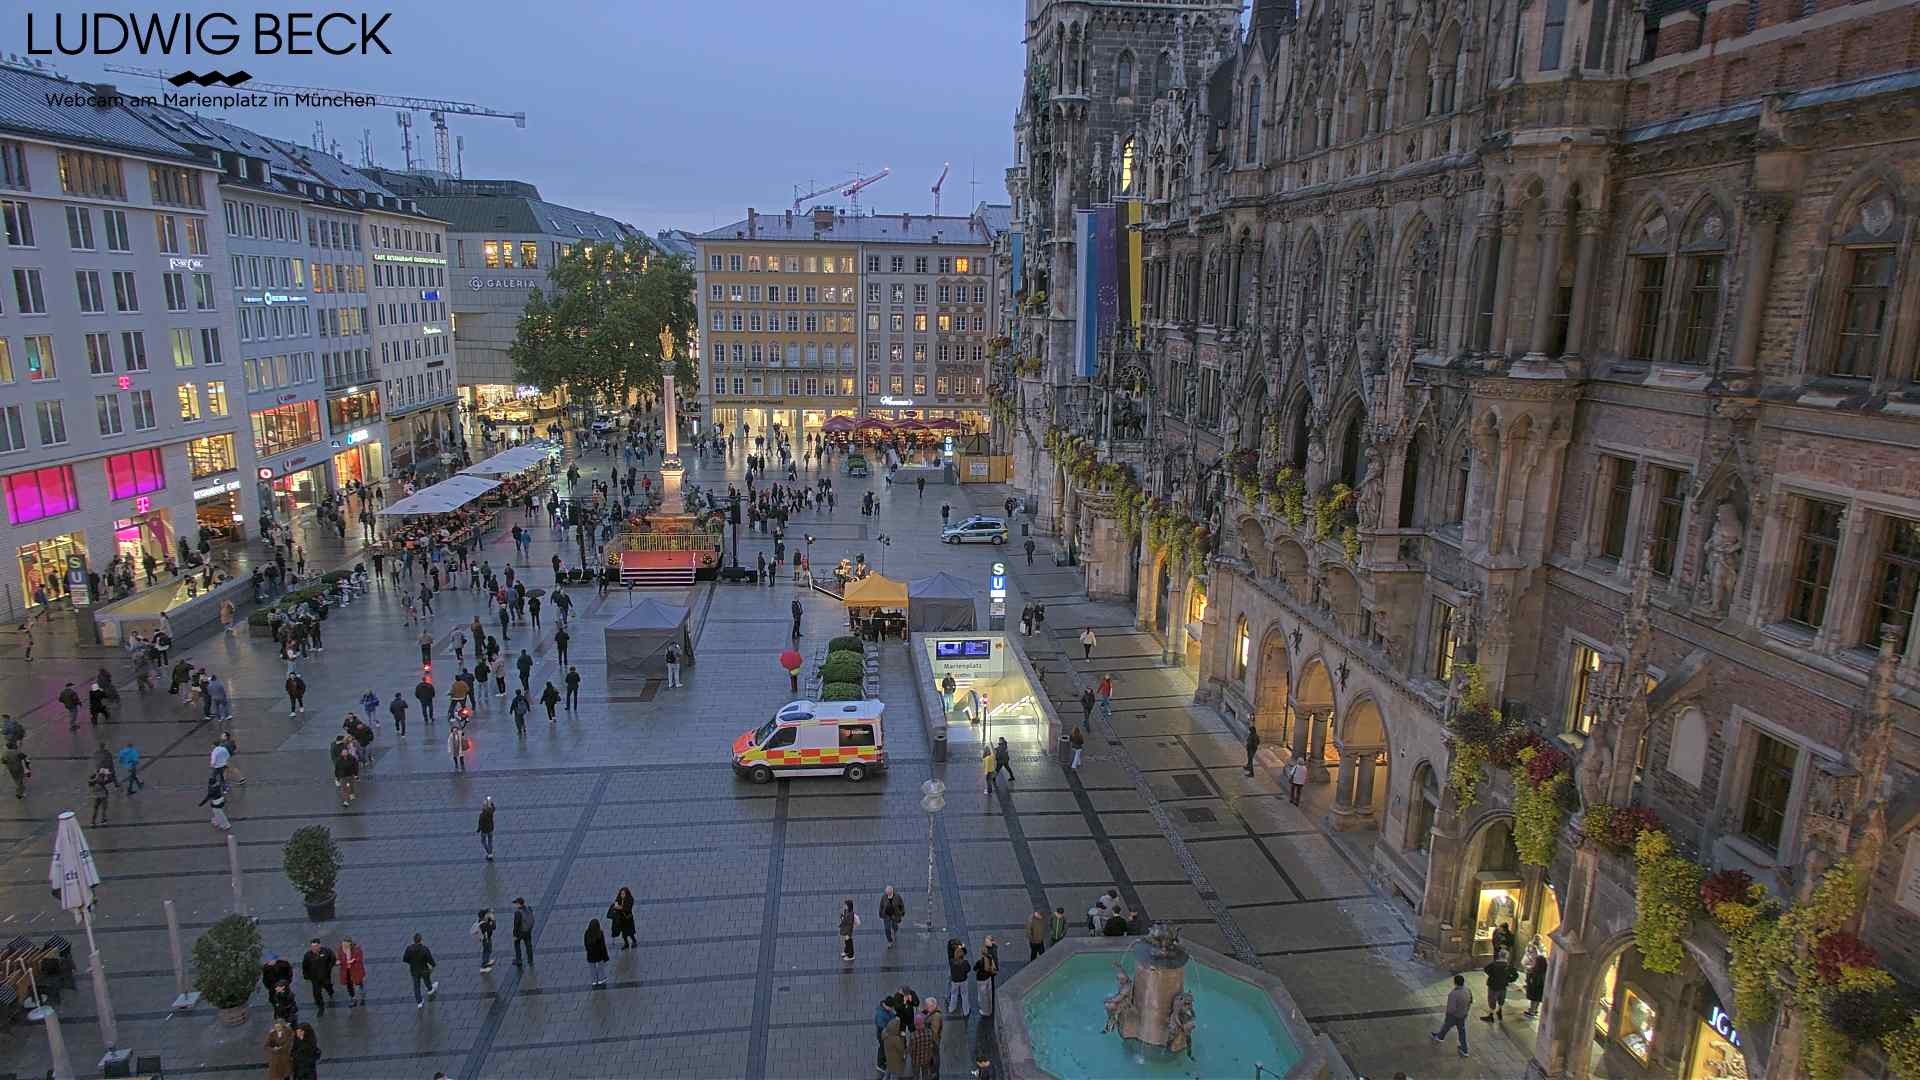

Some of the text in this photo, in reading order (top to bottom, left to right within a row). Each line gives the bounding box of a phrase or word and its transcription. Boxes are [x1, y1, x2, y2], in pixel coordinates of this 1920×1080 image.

[486, 279, 537, 289] GALERIA
[70, 557, 81, 569] S
[993, 562, 1005, 575] S
[71, 571, 82, 584] U
[993, 576, 1003, 589] U
[943, 663, 982, 671] Marienplatz
